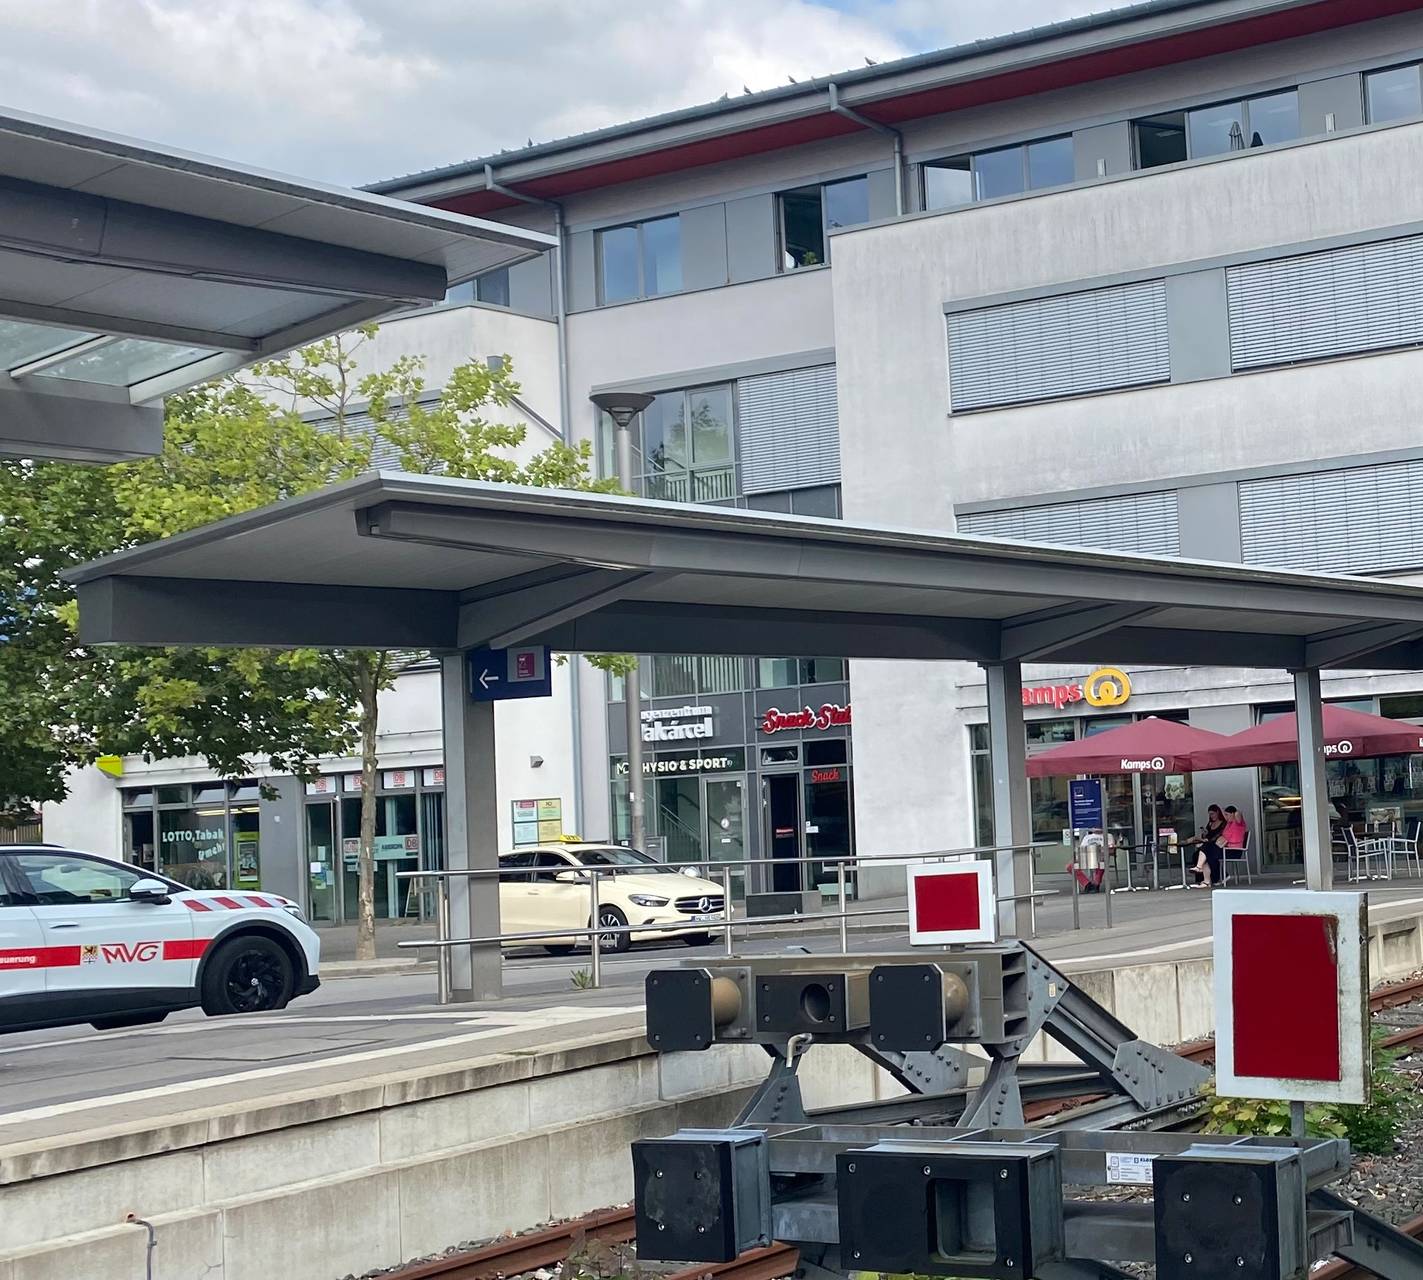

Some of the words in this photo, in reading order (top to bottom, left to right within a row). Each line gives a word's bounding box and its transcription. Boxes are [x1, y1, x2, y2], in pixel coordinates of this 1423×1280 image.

[1022, 684, 1083, 709] amps
[762, 707, 816, 734] Snack
[642, 761, 677, 773] HYSIO
[679, 760, 687, 770] &
[688, 758, 727, 770] SPORT
[1121, 758, 1151, 771] Kamps
[811, 768, 840, 783] Snack
[100, 941, 162, 964] MVG
